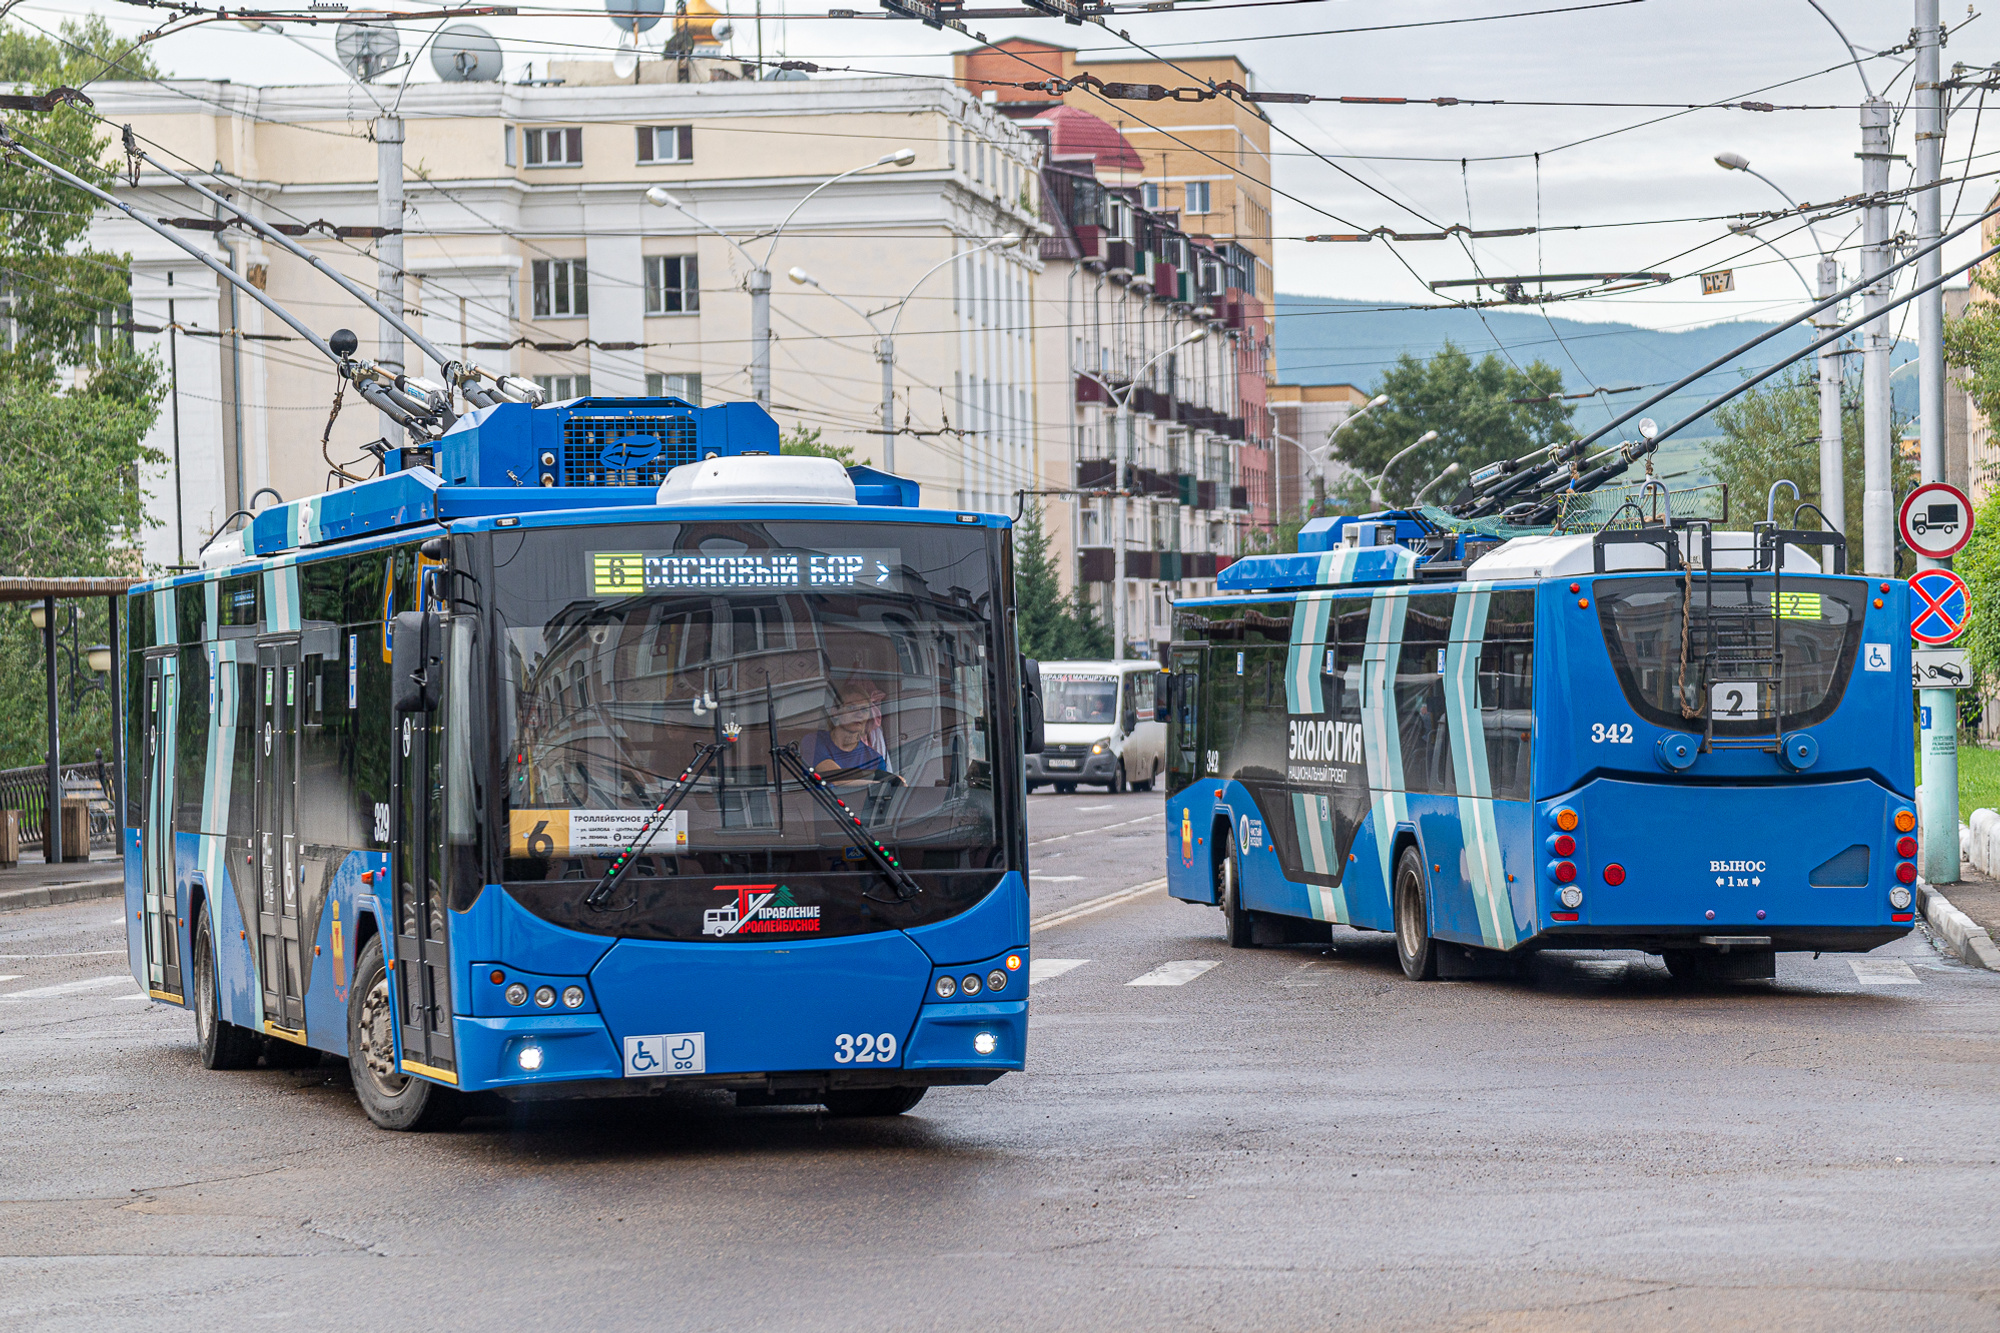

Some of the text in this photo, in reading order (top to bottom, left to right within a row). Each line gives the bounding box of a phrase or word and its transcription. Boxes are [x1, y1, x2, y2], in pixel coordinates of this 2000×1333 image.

[609, 557, 625, 587] 6
[645, 554, 864, 588] СОСНОВЫЙ БОР
[1789, 594, 1800, 616] 2
[1726, 690, 1743, 717] 2
[1289, 720, 1362, 764] ЭКОЛОГИЯ
[1591, 723, 1634, 744] 342
[1206, 750, 1219, 773] 342
[1288, 764, 1347, 784] НАЦИОНАЛЬНЫЙ ПРОЕКТ
[374, 802, 390, 843] 329
[573, 814, 666, 823] ТРОЛЛЕЙБУСНОЕ ДПО
[527, 820, 554, 858] 6
[1709, 860, 1767, 873] ВЫНОС
[1727, 875, 1749, 887] 1 м
[834, 1032, 897, 1064] 329
